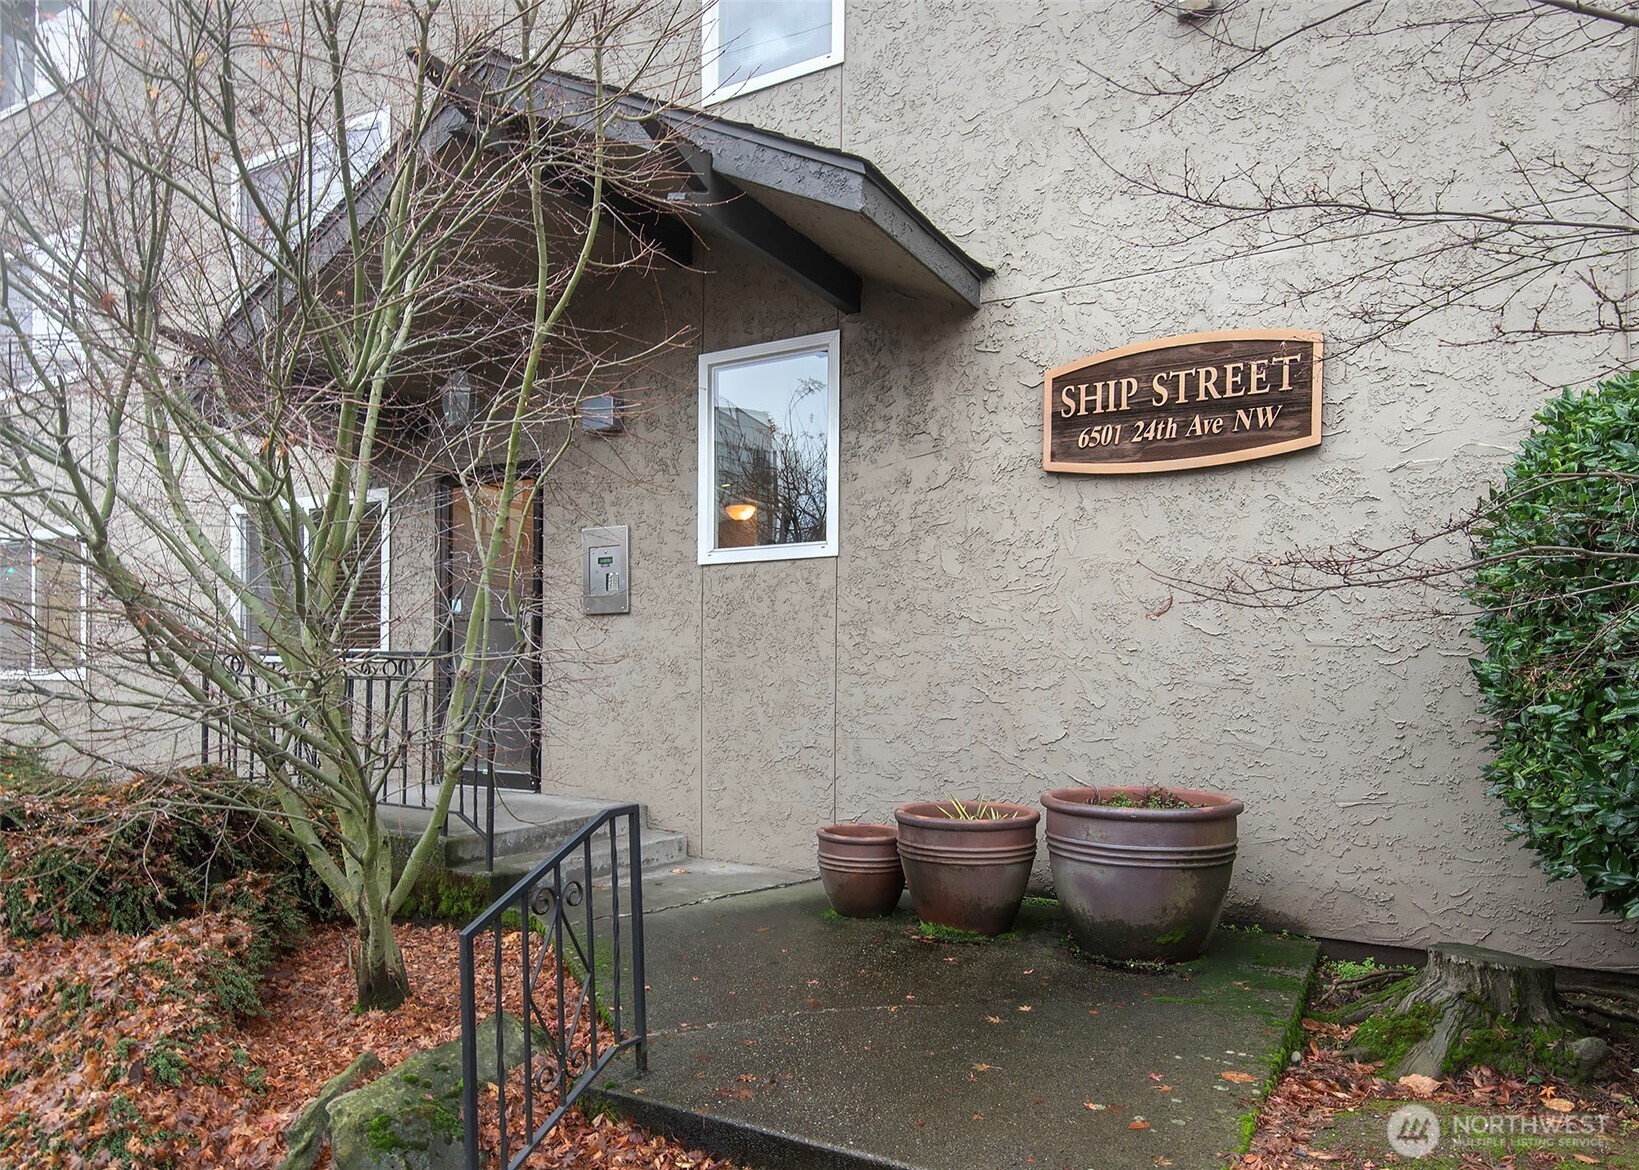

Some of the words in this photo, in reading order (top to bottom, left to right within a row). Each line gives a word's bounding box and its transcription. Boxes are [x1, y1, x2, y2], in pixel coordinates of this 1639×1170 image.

[1061, 377, 1138, 418] SHIP
[1152, 354, 1301, 407] STREET
[1078, 424, 1121, 449] 6501
[1131, 417, 1177, 443] 24th
[1185, 414, 1224, 437] Ave
[1233, 405, 1284, 432] NW
